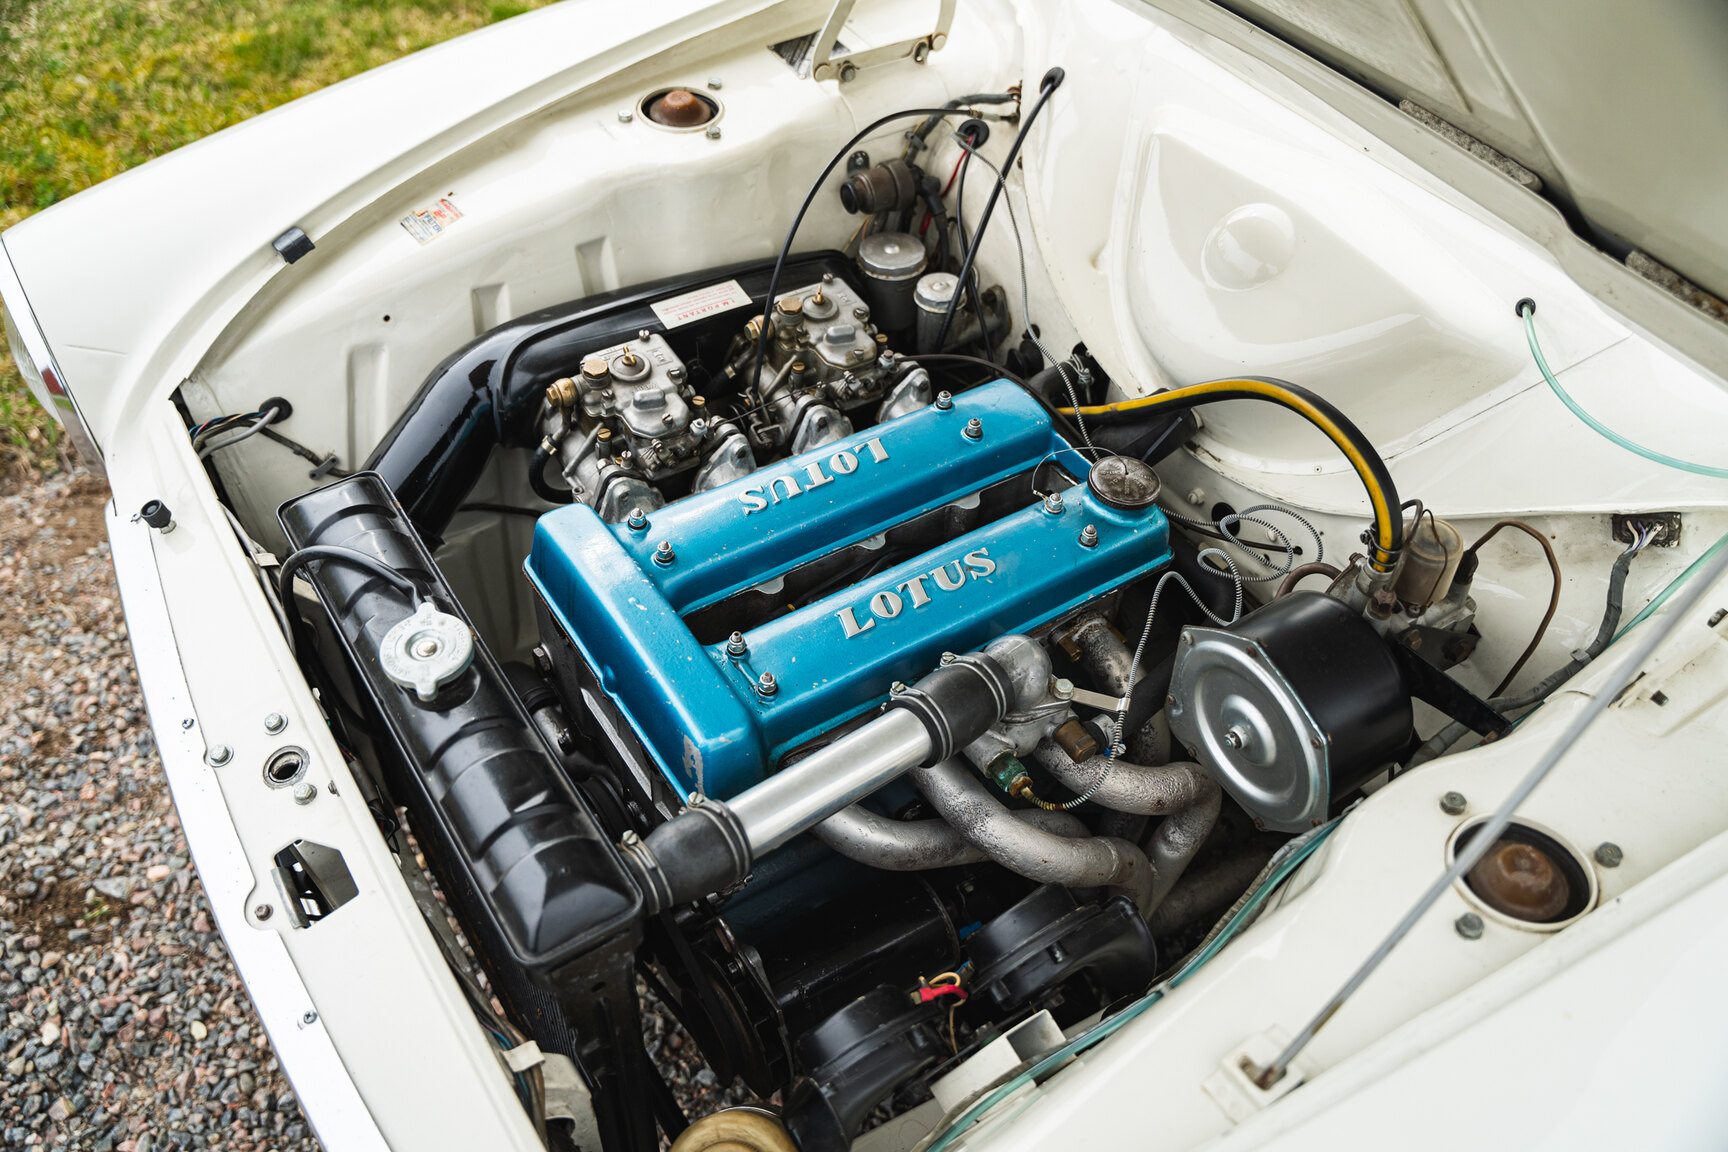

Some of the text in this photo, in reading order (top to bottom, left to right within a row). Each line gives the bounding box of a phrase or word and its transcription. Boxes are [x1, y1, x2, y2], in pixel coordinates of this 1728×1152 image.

[675, 299, 736, 321] IMPORTANT
[738, 437, 889, 516] LOTUS
[835, 547, 997, 639] LOTUS
